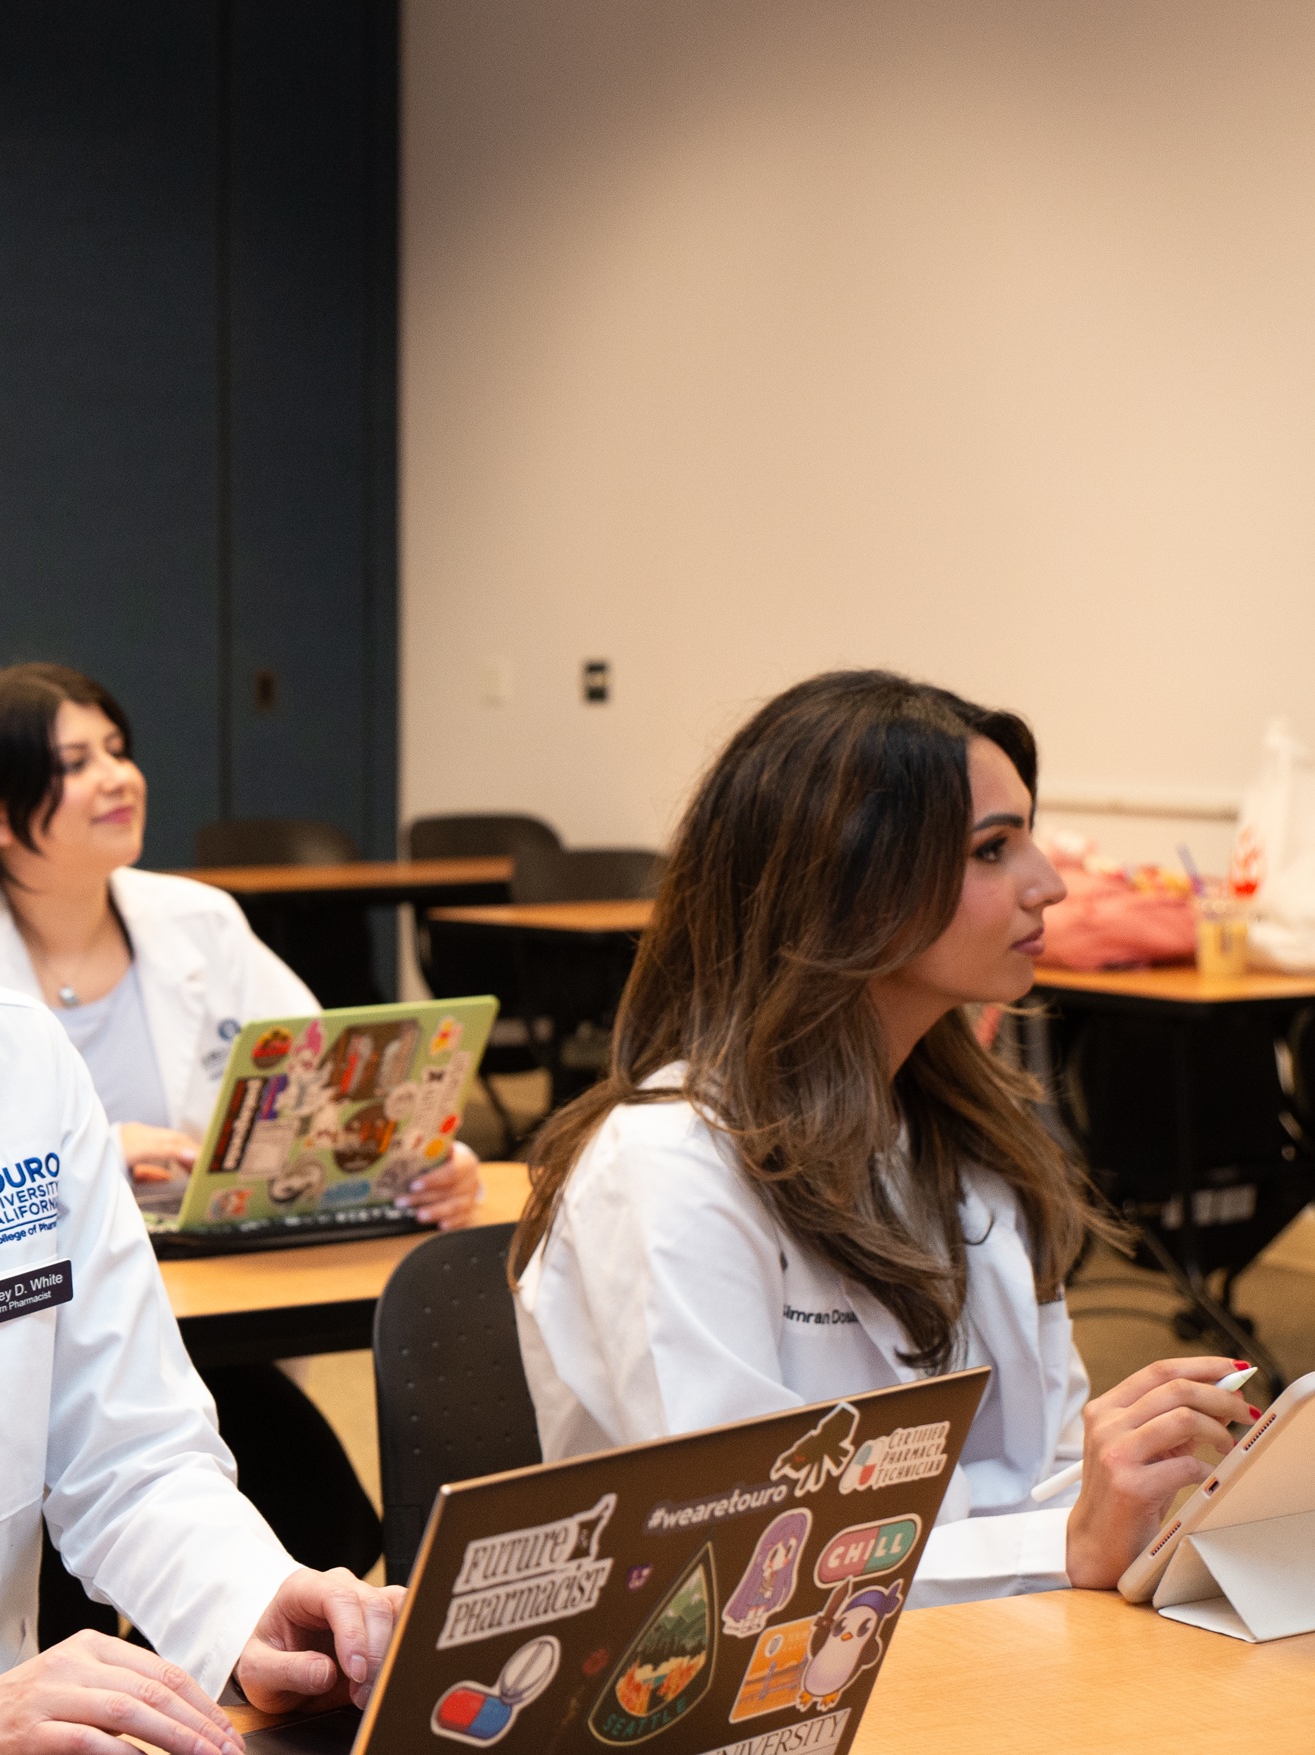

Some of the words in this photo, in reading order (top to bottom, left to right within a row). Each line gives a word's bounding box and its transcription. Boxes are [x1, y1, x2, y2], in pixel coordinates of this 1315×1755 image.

[28, 1224, 37, 1236] of
[14, 1283, 27, 1297] D.
[30, 1274, 63, 1291] White
[8, 1290, 52, 1310] Pharmacist
[880, 1442, 942, 1468] PHARMACY
[875, 1459, 943, 1486] TECHNICIAN
[647, 1484, 788, 1530] #wearetouro
[827, 1533, 903, 1569] CHILL
[602, 1696, 687, 1737] SEATTLE
